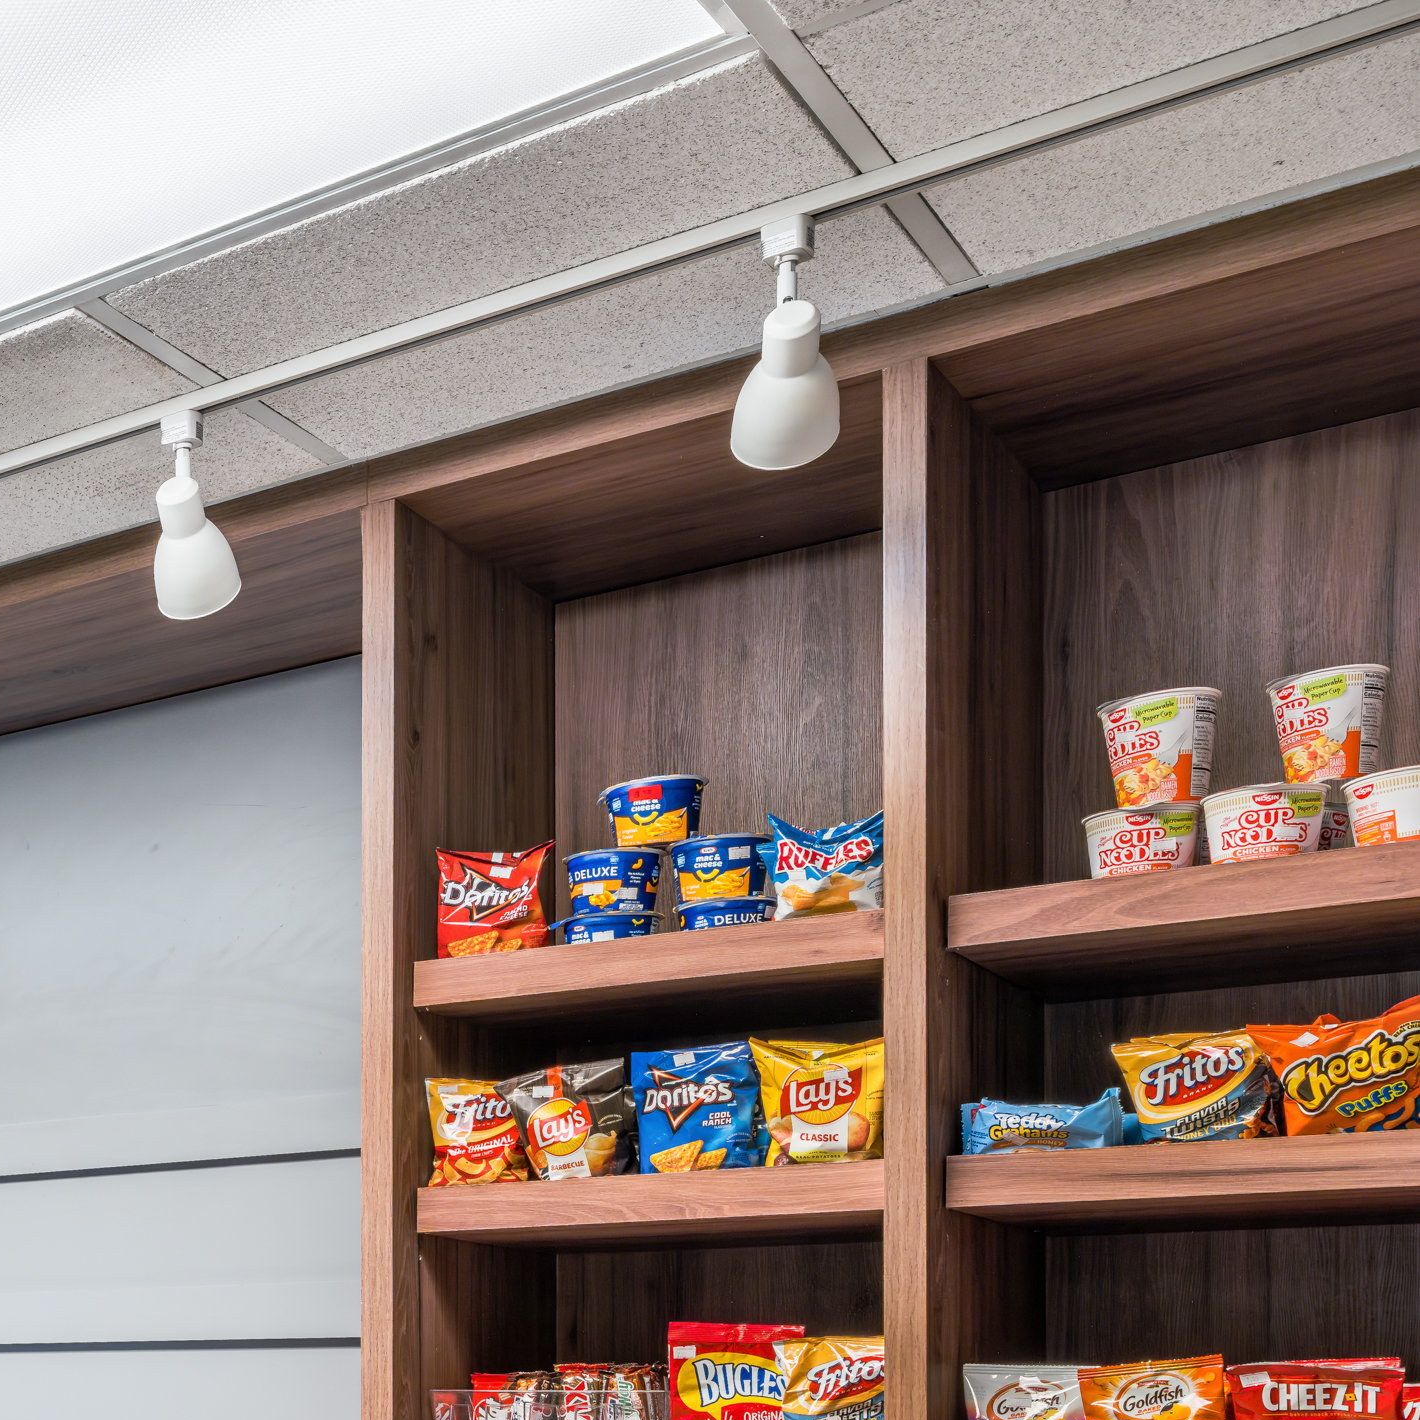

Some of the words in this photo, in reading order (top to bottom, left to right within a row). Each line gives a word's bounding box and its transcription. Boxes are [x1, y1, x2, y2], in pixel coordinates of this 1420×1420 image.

[1303, 678, 1344, 694] Microwavable
[1311, 691, 1328, 700] Paper
[1329, 687, 1341, 696] Cup
[1135, 701, 1175, 717] Microwavable
[1142, 714, 1159, 723] Paper
[1160, 710, 1173, 720] Cup
[1254, 794, 1280, 803] NISSIN
[1354, 786, 1373, 797] NISSIN
[1127, 815, 1152, 823] NISSIN
[1239, 807, 1295, 828] CUP
[1114, 828, 1167, 848] CUP
[777, 837, 874, 872] RUFFLES
[1236, 845, 1279, 857] CHICKEN
[574, 866, 618, 881] DELUXE
[1111, 864, 1152, 875] CHICKEN
[444, 877, 531, 907] Doritos
[714, 913, 763, 926] DELUXE
[1140, 1046, 1244, 1106] Fritos
[1285, 1032, 1420, 1110] Cheetos
[642, 1080, 735, 1114] Doritos
[790, 1075, 853, 1112] Lays
[1182, 1084, 1213, 1099] BRAND
[1335, 1080, 1409, 1118] Puffs
[709, 1111, 731, 1119] COOL
[1176, 1097, 1227, 1127] FLAVOR
[532, 1106, 587, 1148] Lay's
[702, 1118, 732, 1127] RANCH
[995, 1112, 1065, 1131] Teddy
[799, 1133, 839, 1142] CLASSIC
[1036, 1139, 1064, 1147] HONEY
[550, 1160, 585, 1171] BARBECUE
[693, 1358, 788, 1408] BUGLES
[1122, 1386, 1186, 1413] Goldfish
[1262, 1381, 1381, 1415] CHEEZ-IT
[1138, 1404, 1161, 1414] BAKED
